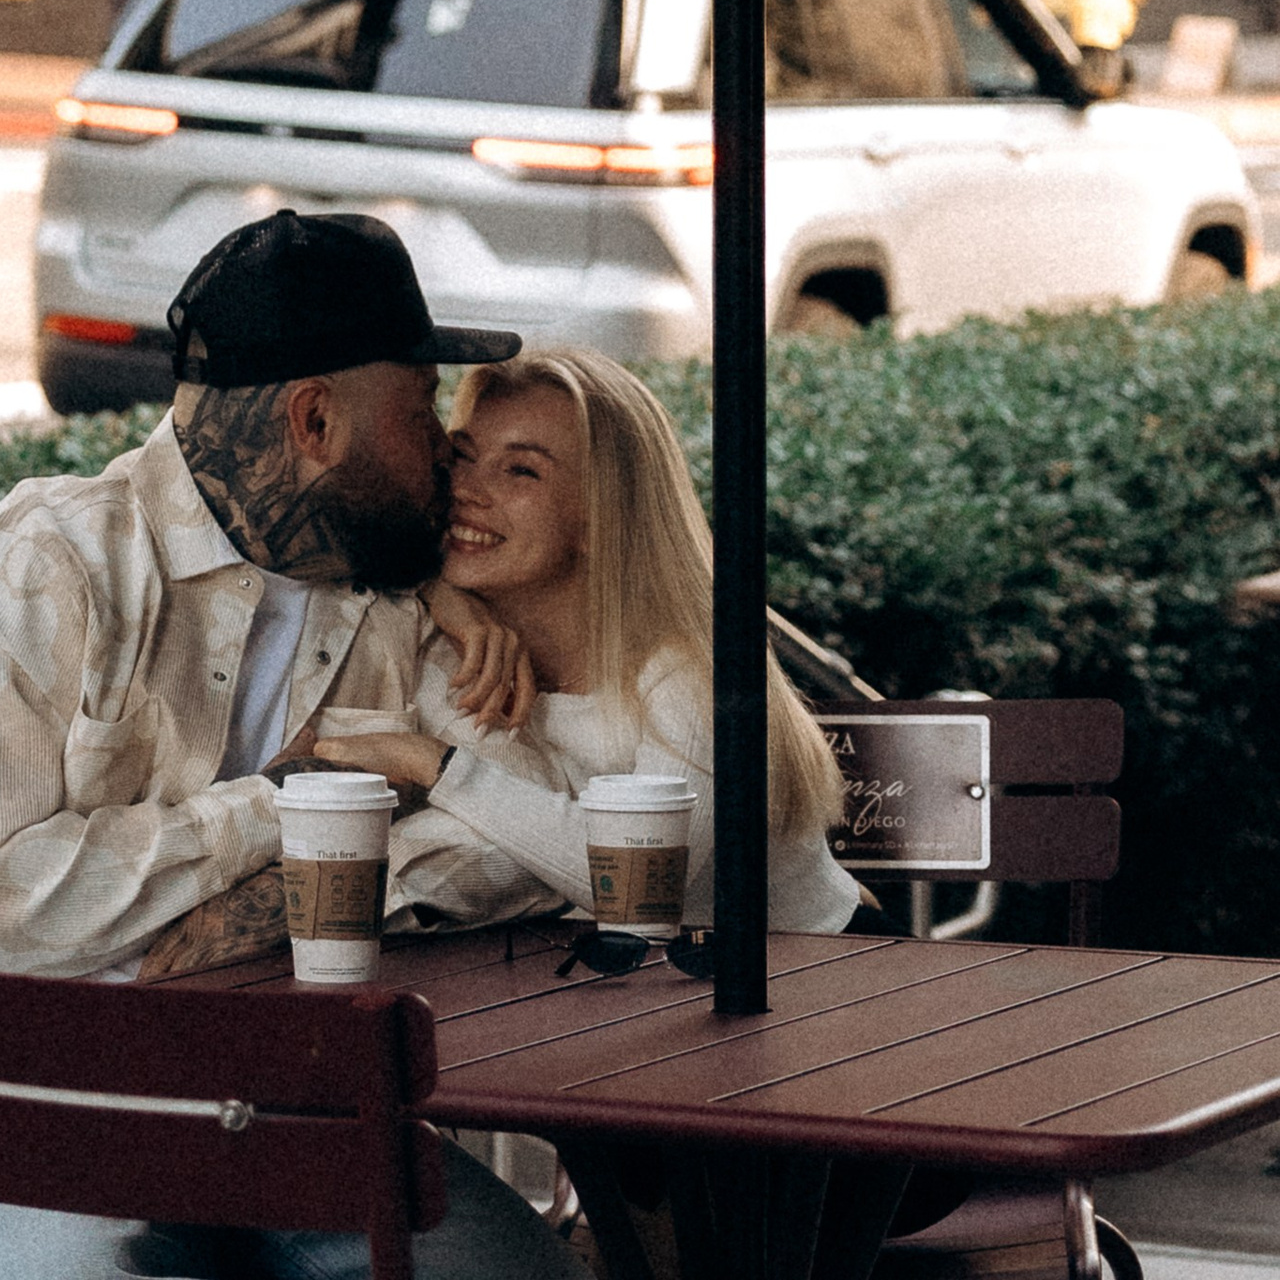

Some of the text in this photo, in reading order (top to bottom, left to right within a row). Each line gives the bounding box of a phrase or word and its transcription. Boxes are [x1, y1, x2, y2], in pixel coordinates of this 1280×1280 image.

[857, 815, 907, 829] DIEGO
[623, 836, 664, 846] That first
[317, 850, 358, 859] That first
